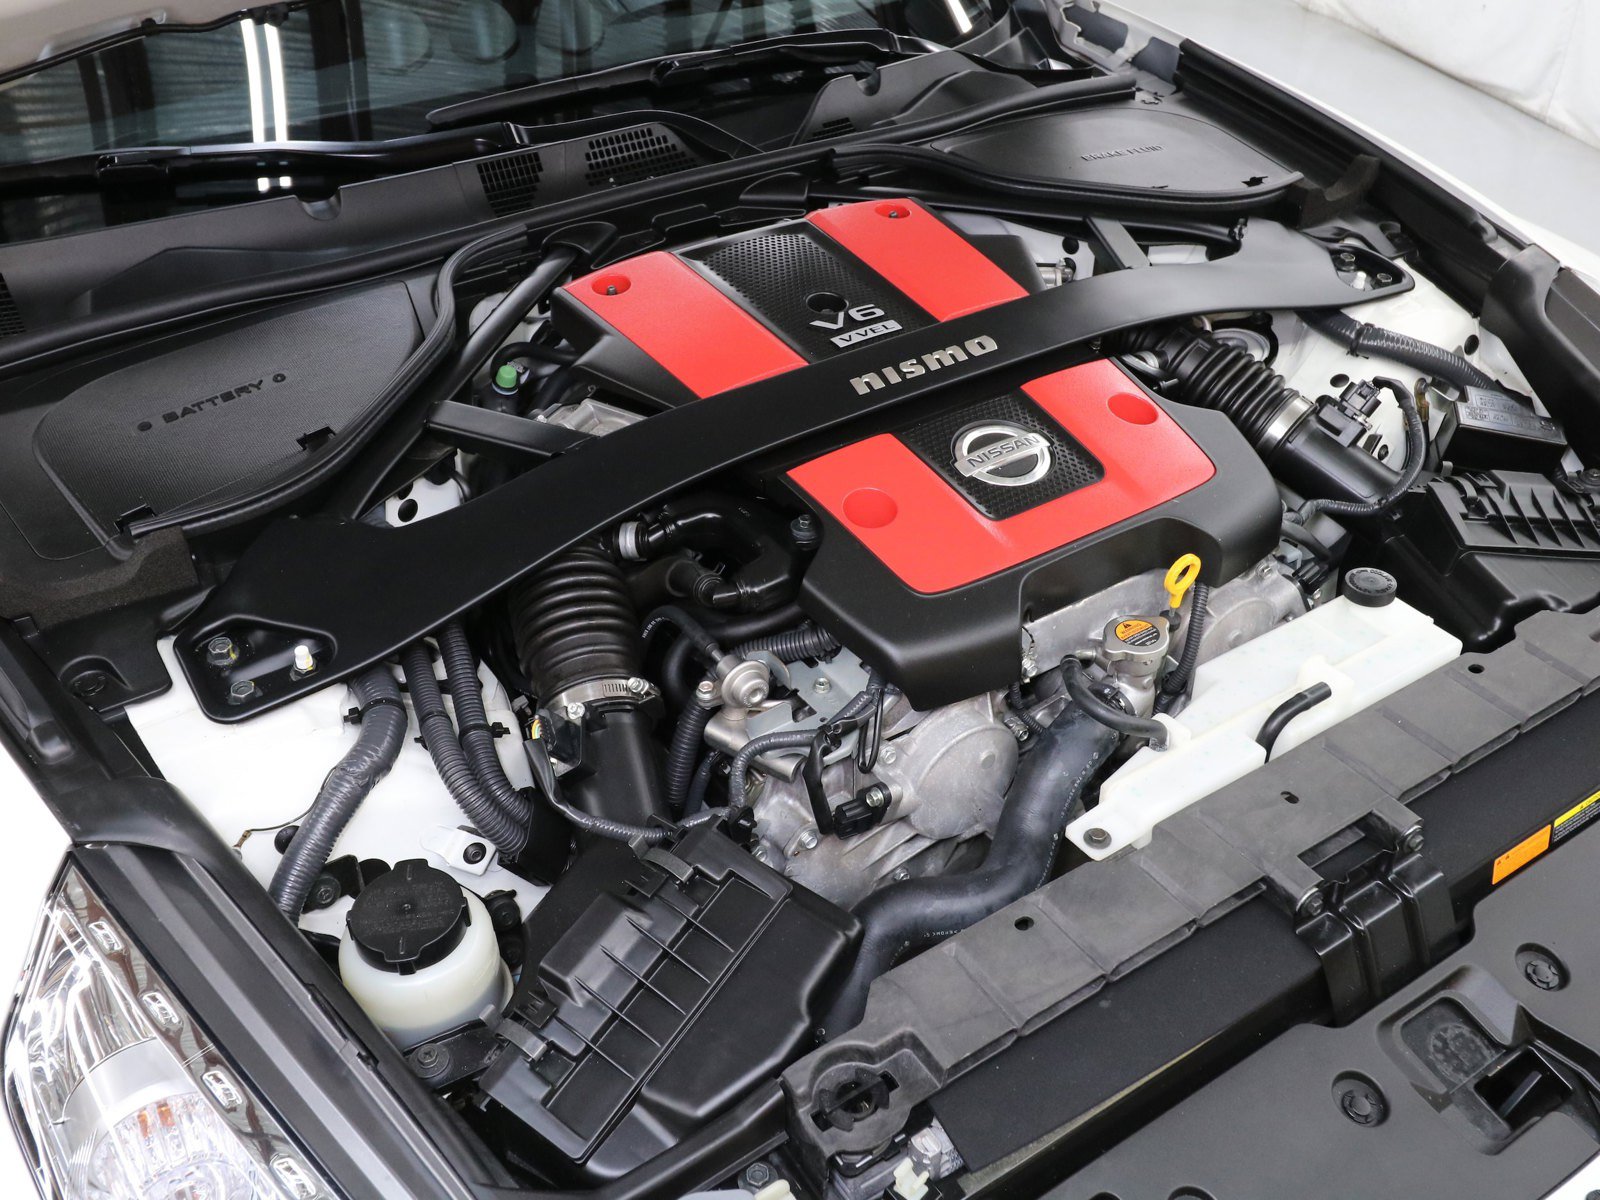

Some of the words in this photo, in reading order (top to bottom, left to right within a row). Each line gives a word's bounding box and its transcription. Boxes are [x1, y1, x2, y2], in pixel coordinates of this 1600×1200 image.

[1081, 150, 1124, 162] BRAKE
[1126, 145, 1164, 156] FLUID
[809, 304, 885, 330] V6
[839, 324, 895, 343] VVEL
[850, 335, 998, 396] nismo
[162, 379, 264, 424] BATTERY
[967, 435, 1041, 468] NISSAN
